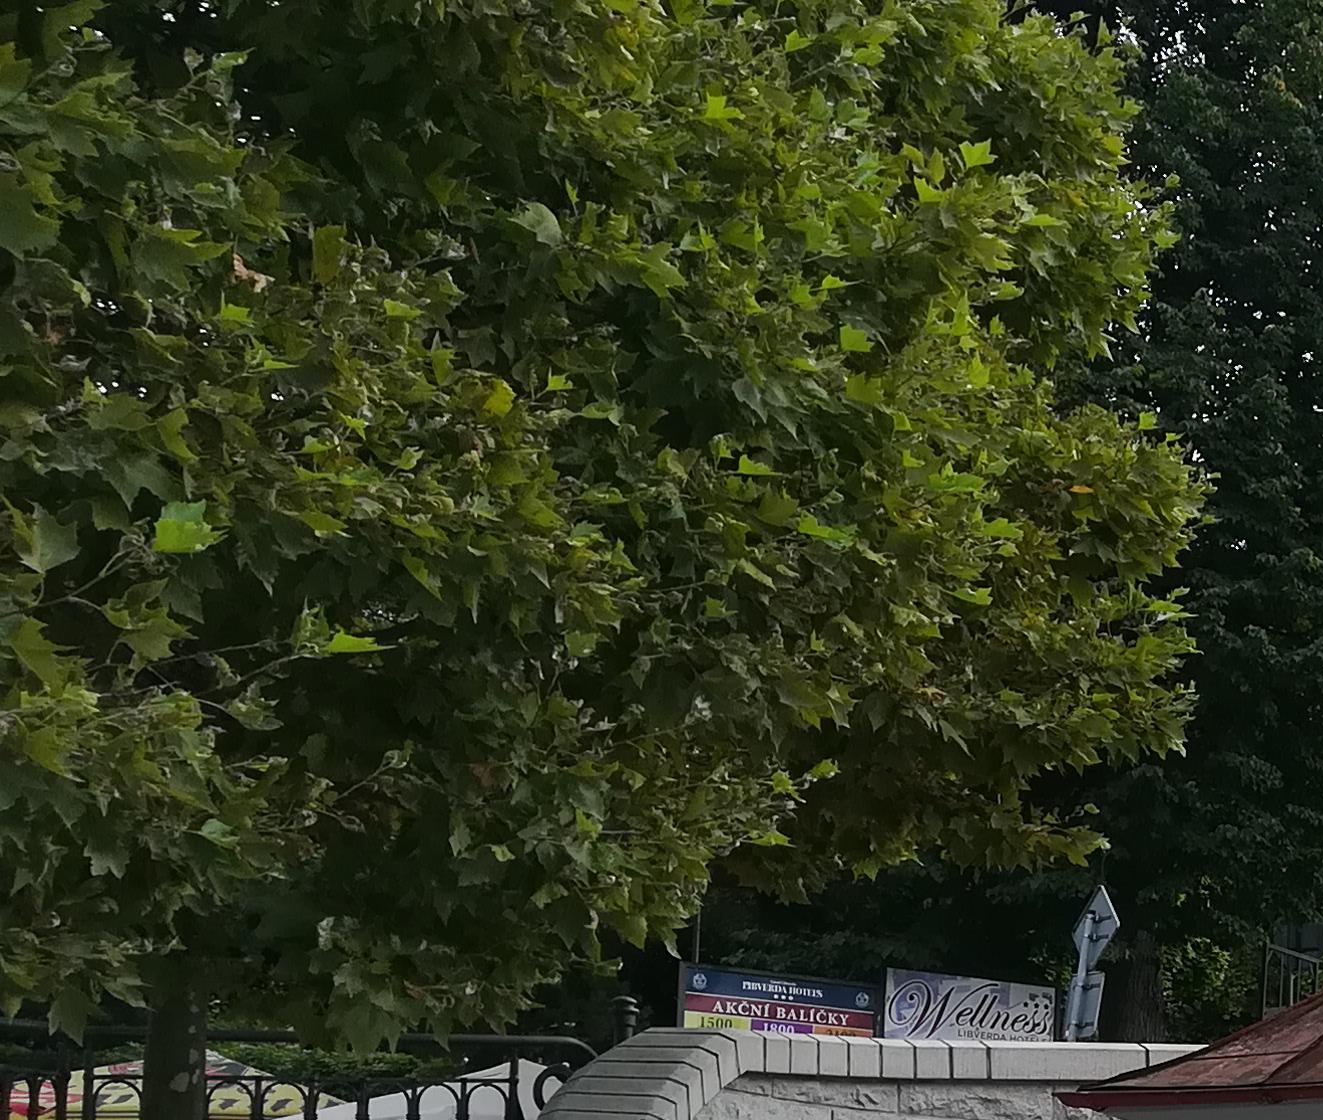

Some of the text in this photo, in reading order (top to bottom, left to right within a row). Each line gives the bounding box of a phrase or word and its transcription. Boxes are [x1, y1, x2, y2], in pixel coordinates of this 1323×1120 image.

[712, 1000, 850, 1026] AKČNÍ BALÍČKY
[888, 979, 1050, 1039] Wellness
[699, 1016, 733, 1029] 1500
[957, 1029, 1007, 1042] LIBVERDA
